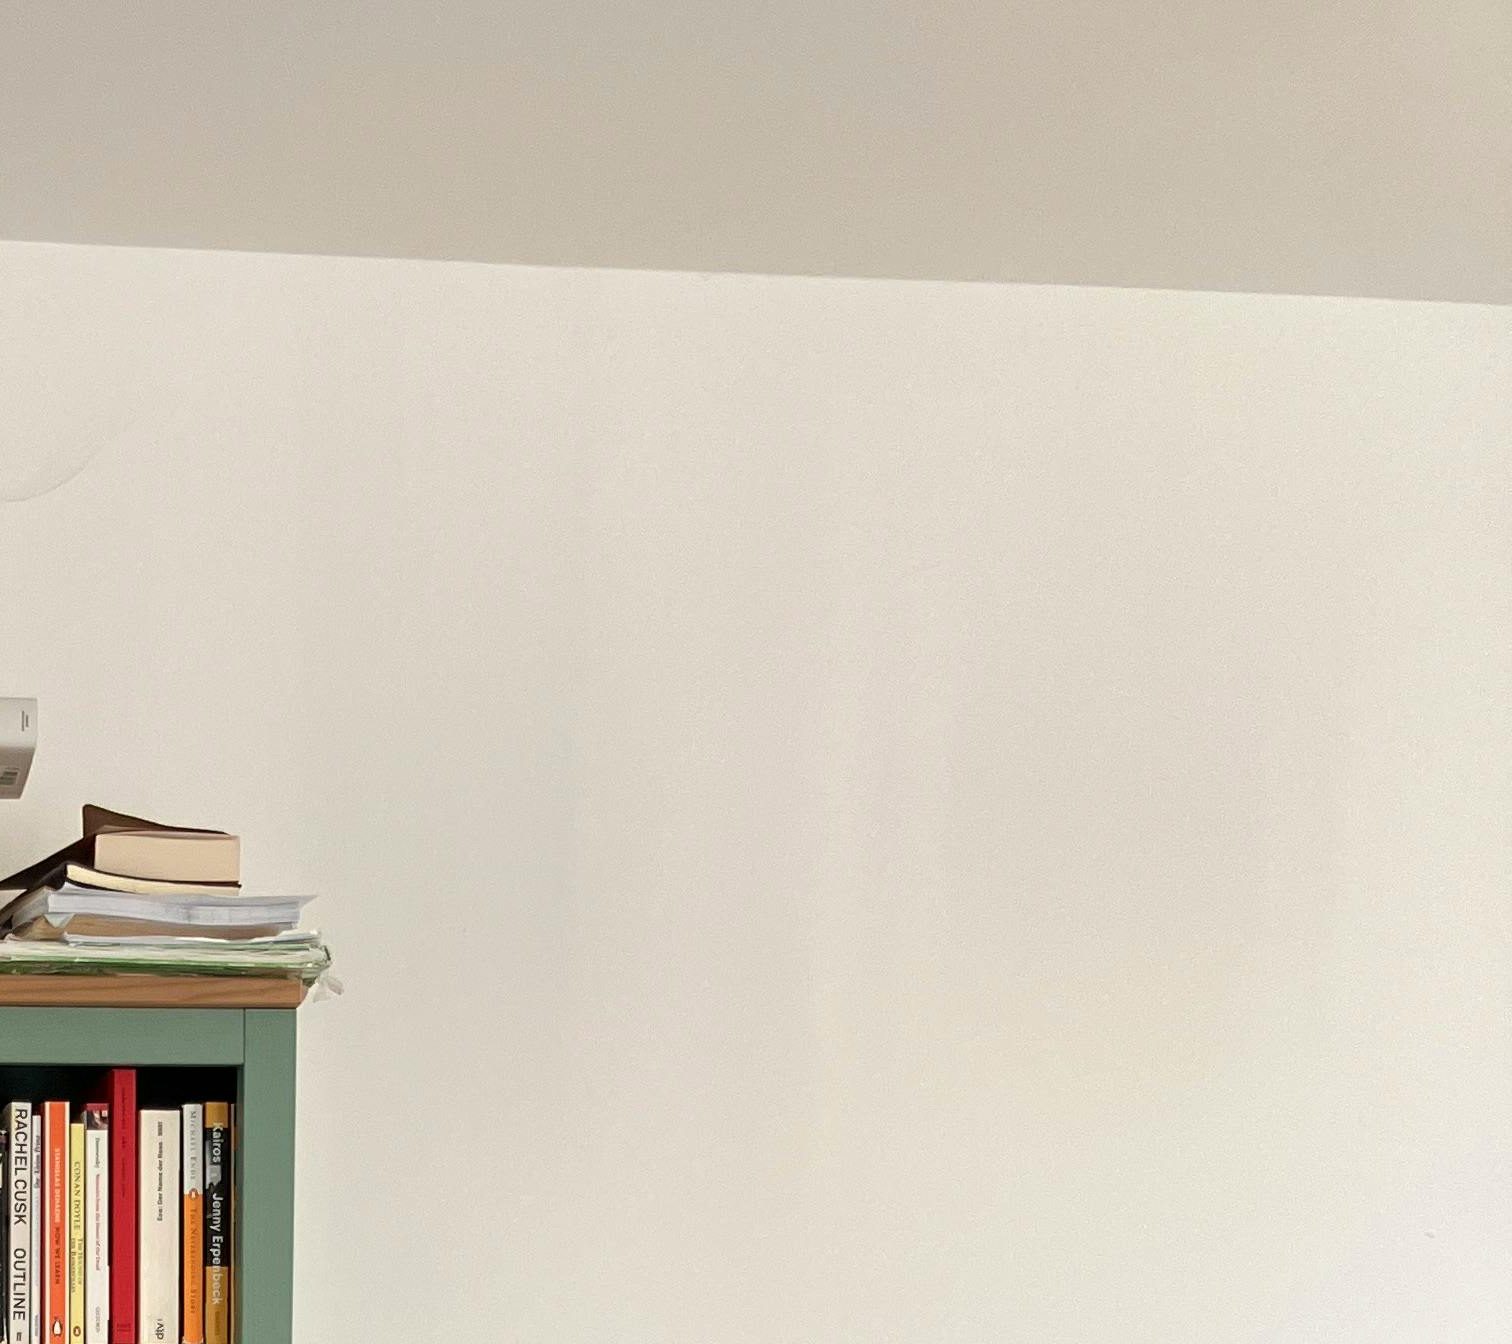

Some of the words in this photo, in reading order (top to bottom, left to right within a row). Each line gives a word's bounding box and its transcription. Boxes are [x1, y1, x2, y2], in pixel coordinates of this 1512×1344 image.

[14, 1108, 28, 1176] RACHEL
[212, 1122, 223, 1163] Kairos
[14, 1179, 27, 1226] CUSK
[74, 1161, 82, 1197] CONAN
[210, 1192, 223, 1231] Jenny
[13, 1248, 27, 1321] OUTLINE
[210, 1235, 223, 1305] Erpenbeck
